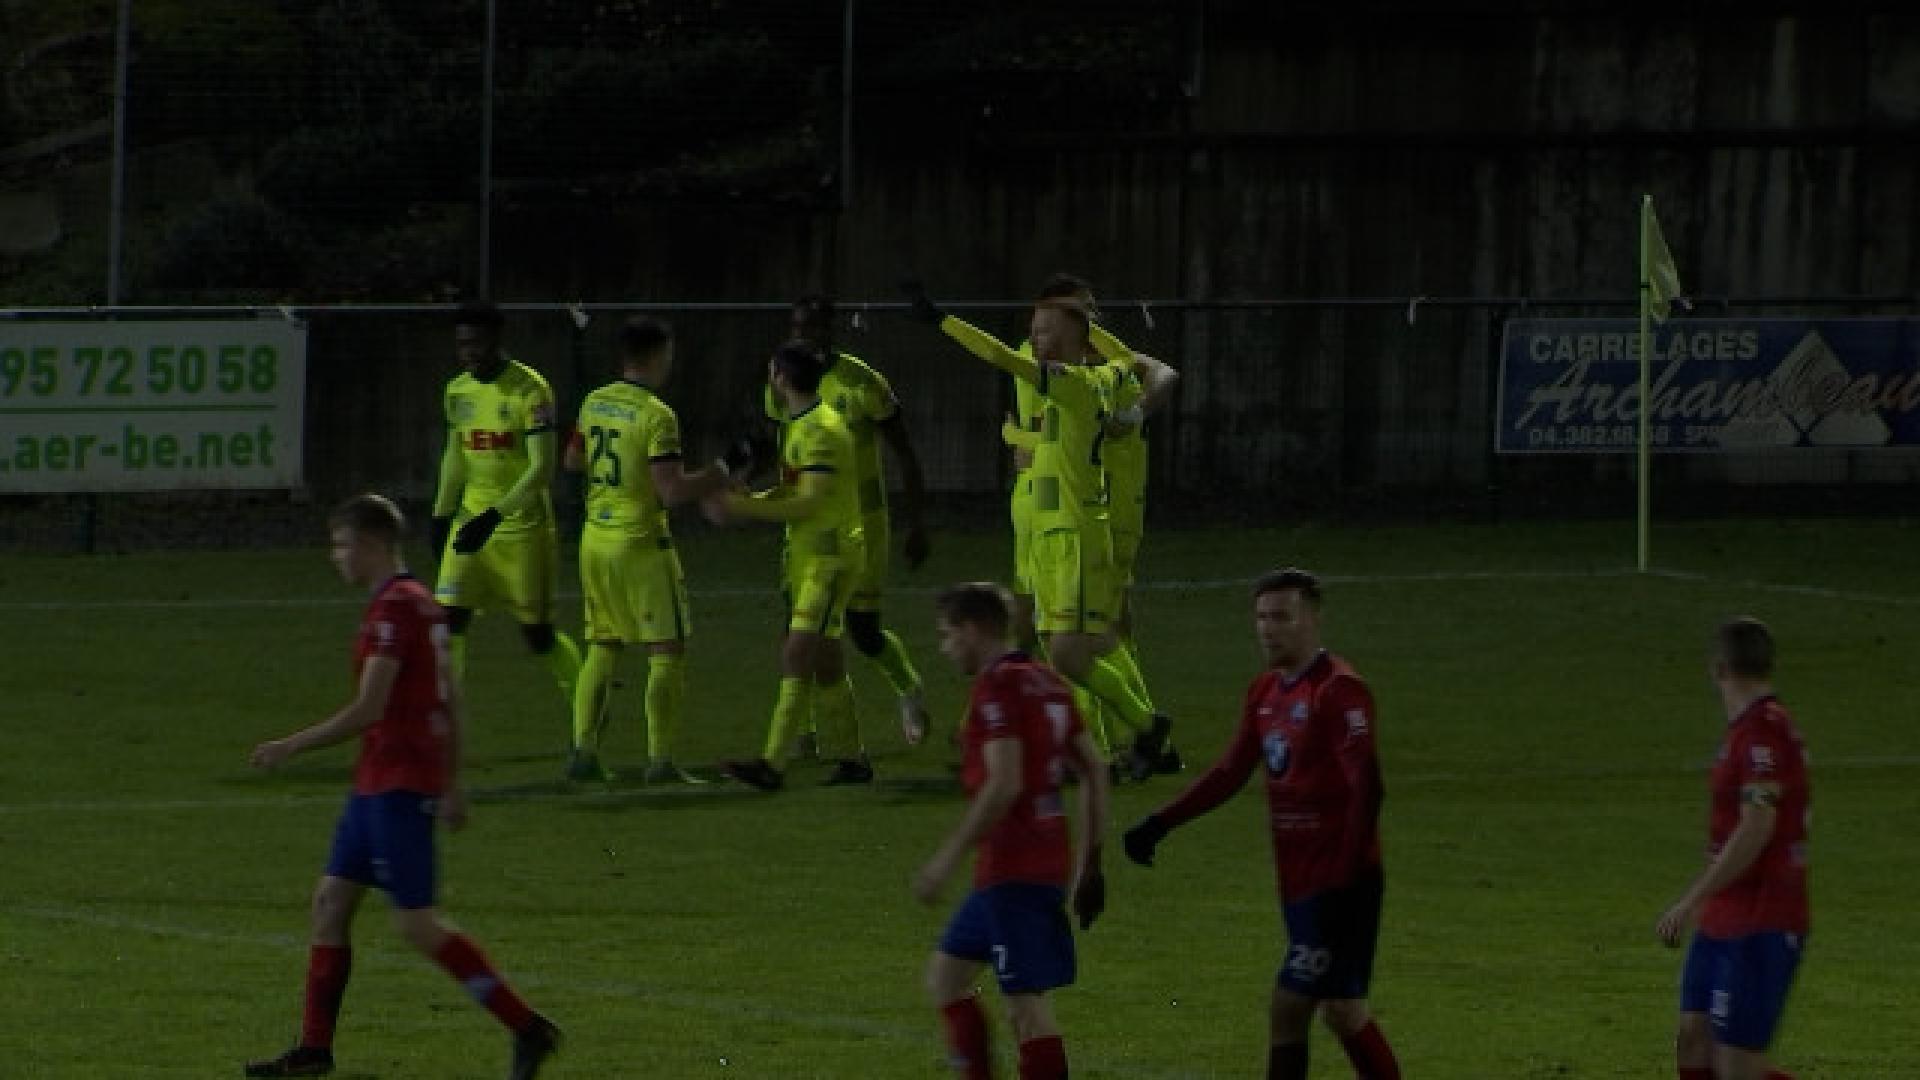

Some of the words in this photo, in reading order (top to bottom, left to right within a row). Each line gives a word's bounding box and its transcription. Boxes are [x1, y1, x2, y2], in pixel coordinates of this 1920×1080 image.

[1529, 330, 1759, 362] CARRELAGES
[0, 347, 57, 397] 95
[74, 347, 134, 395] 72
[149, 347, 205, 394] 50
[218, 345, 277, 393] 58
[590, 426, 621, 487] 25
[1287, 945, 1332, 976] 20
